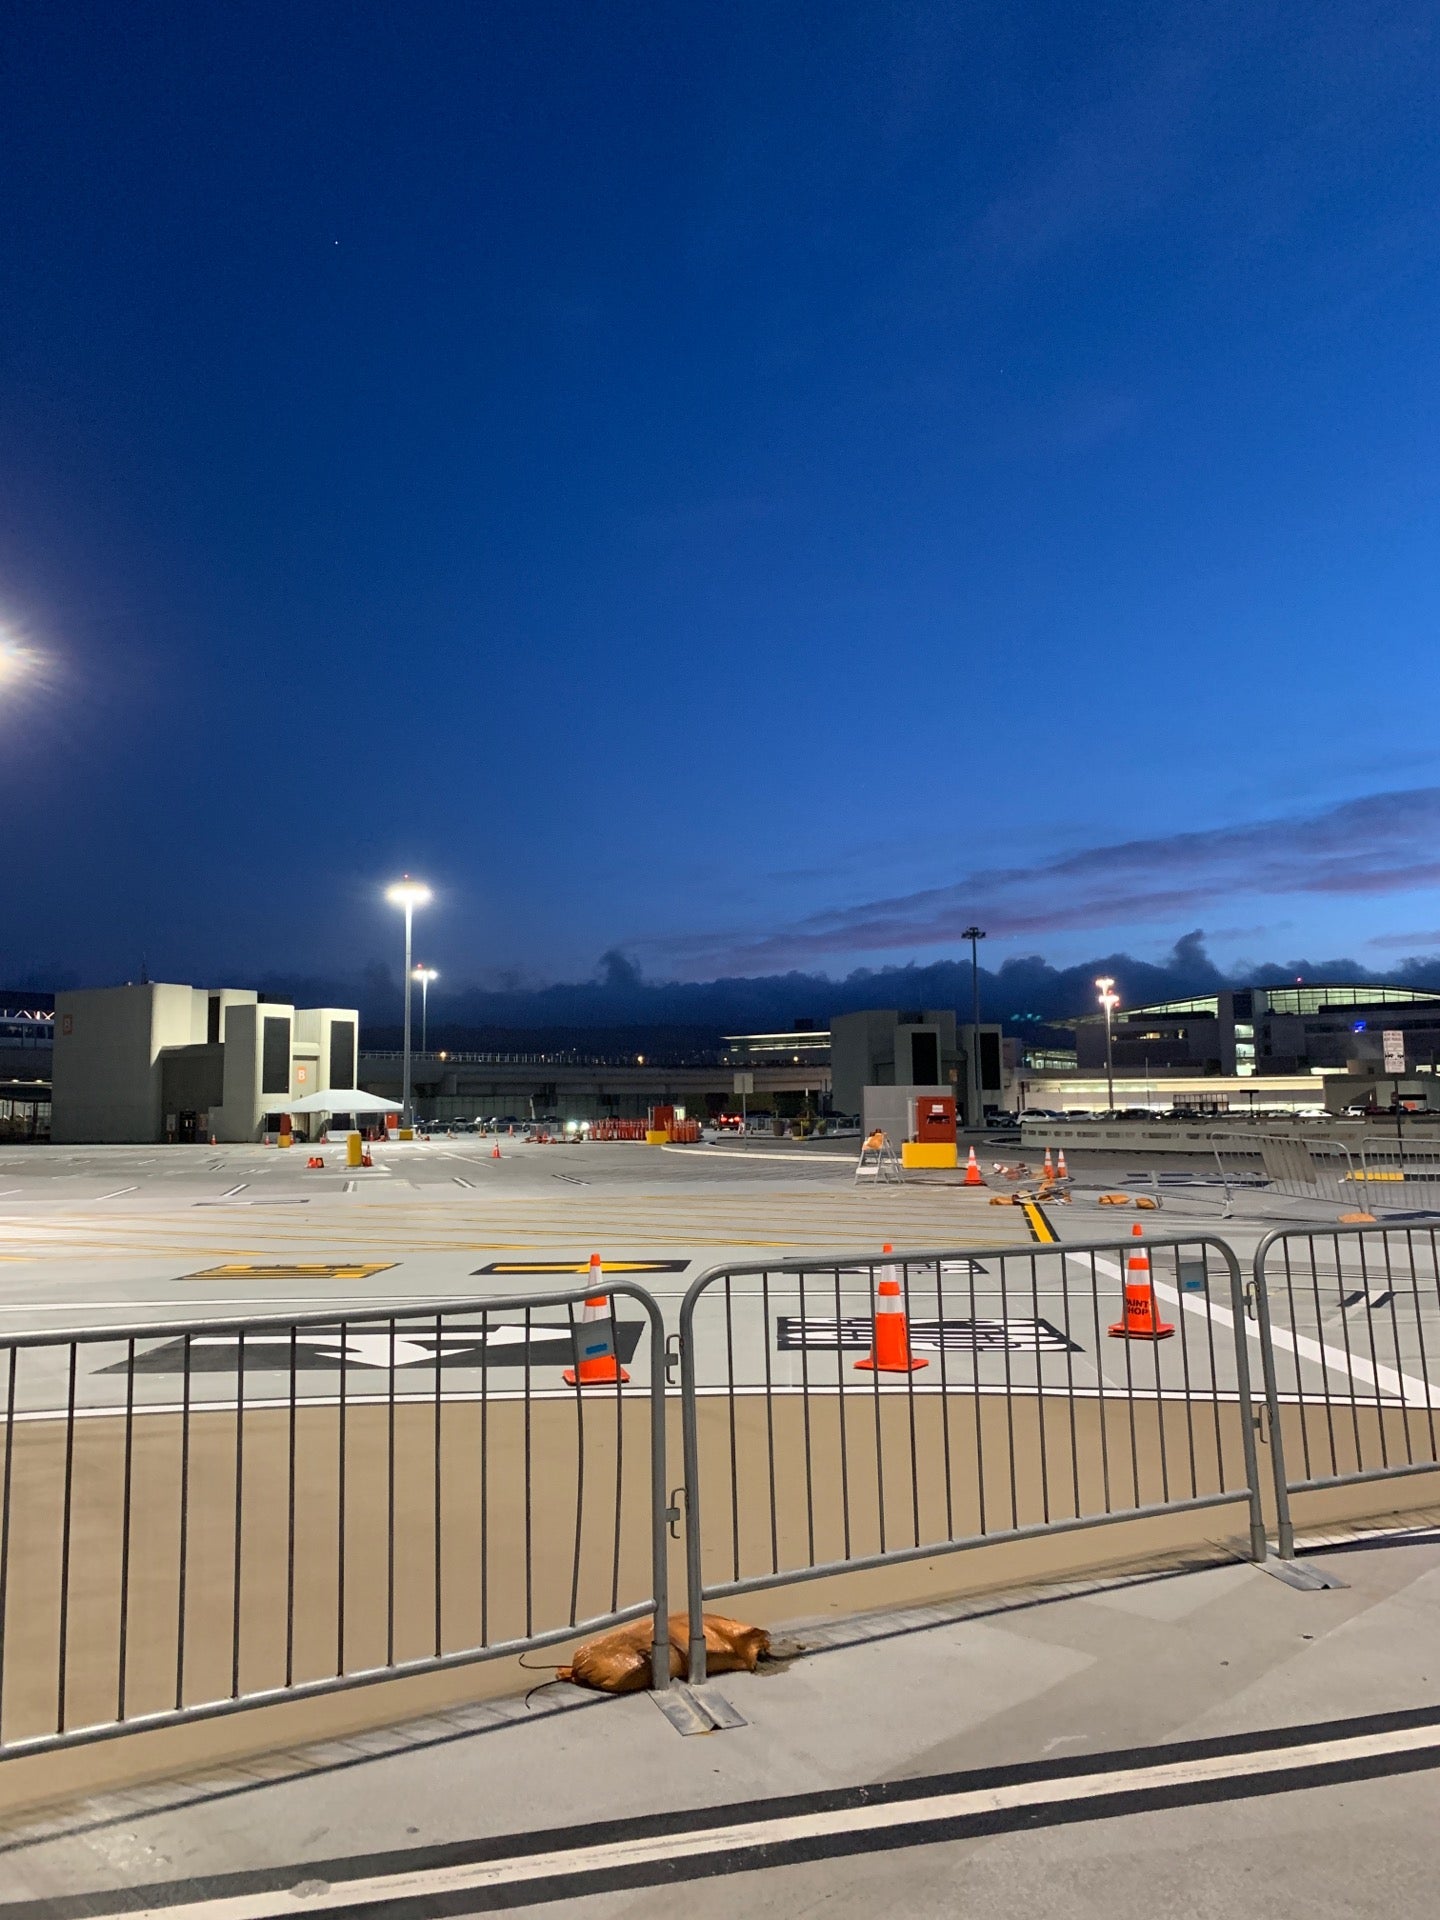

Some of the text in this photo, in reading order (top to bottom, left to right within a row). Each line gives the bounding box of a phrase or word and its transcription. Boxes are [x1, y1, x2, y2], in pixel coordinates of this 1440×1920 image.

[298, 1069, 306, 1081] B
[1125, 1298, 1149, 1308] AINT
[1127, 1306, 1149, 1315] HOP
